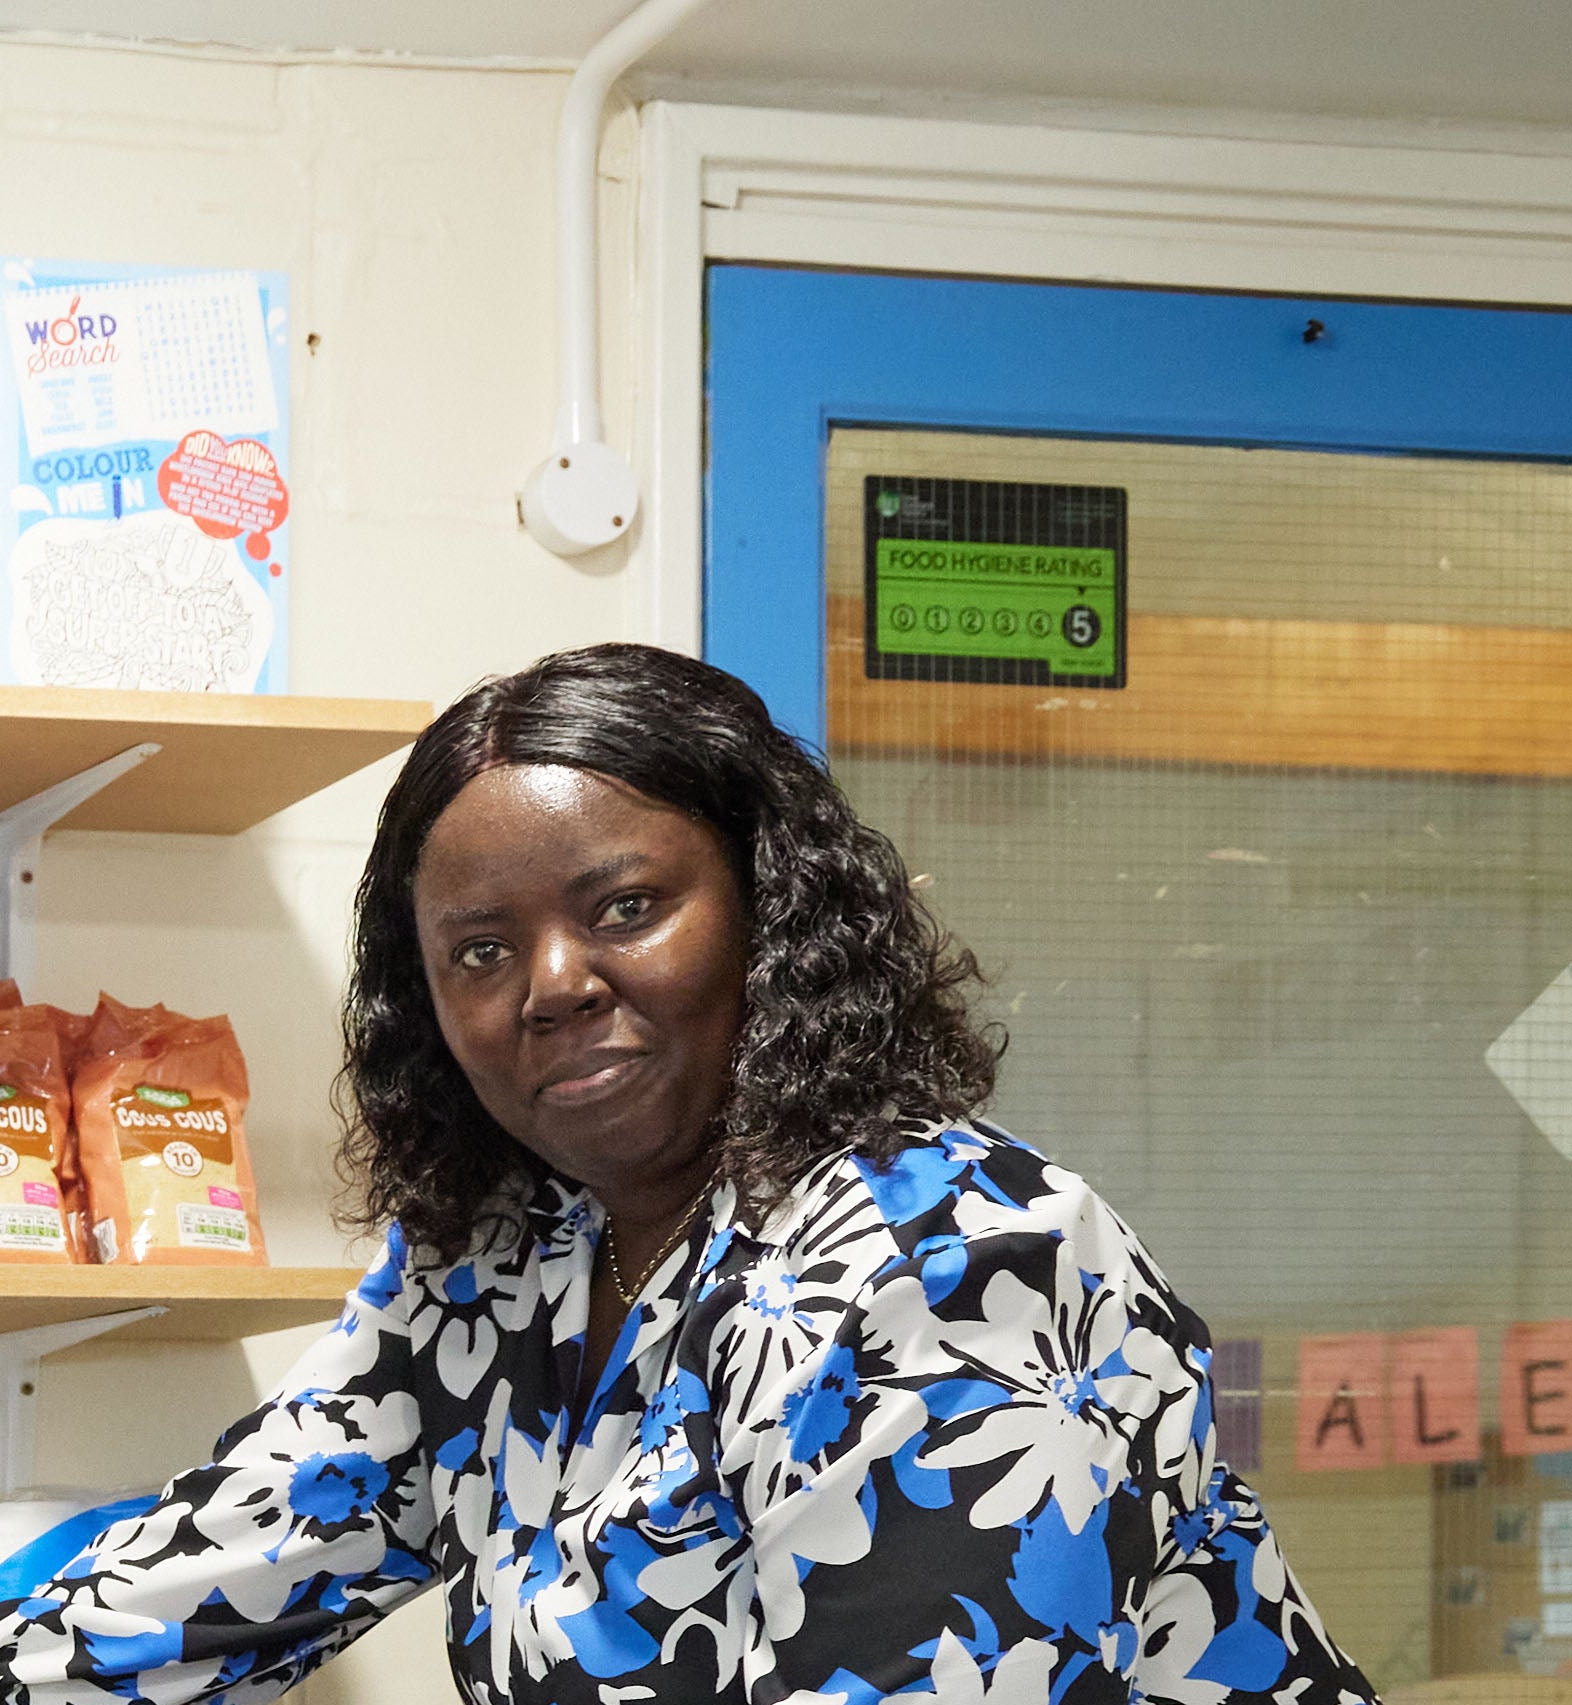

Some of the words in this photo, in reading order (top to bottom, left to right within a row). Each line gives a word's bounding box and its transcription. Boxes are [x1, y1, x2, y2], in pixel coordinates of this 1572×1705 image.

[25, 313, 117, 347] WORD
[26, 336, 119, 379] Search
[32, 447, 155, 484] COLOUR
[889, 550, 946, 571] FOOD
[952, 554, 1032, 575] HYGIENE
[1036, 556, 1102, 578] RATING
[1071, 609, 1093, 643] 5
[116, 1106, 171, 1129] COUS
[173, 1110, 228, 1134] COUS
[171, 1153, 194, 1168] 10
